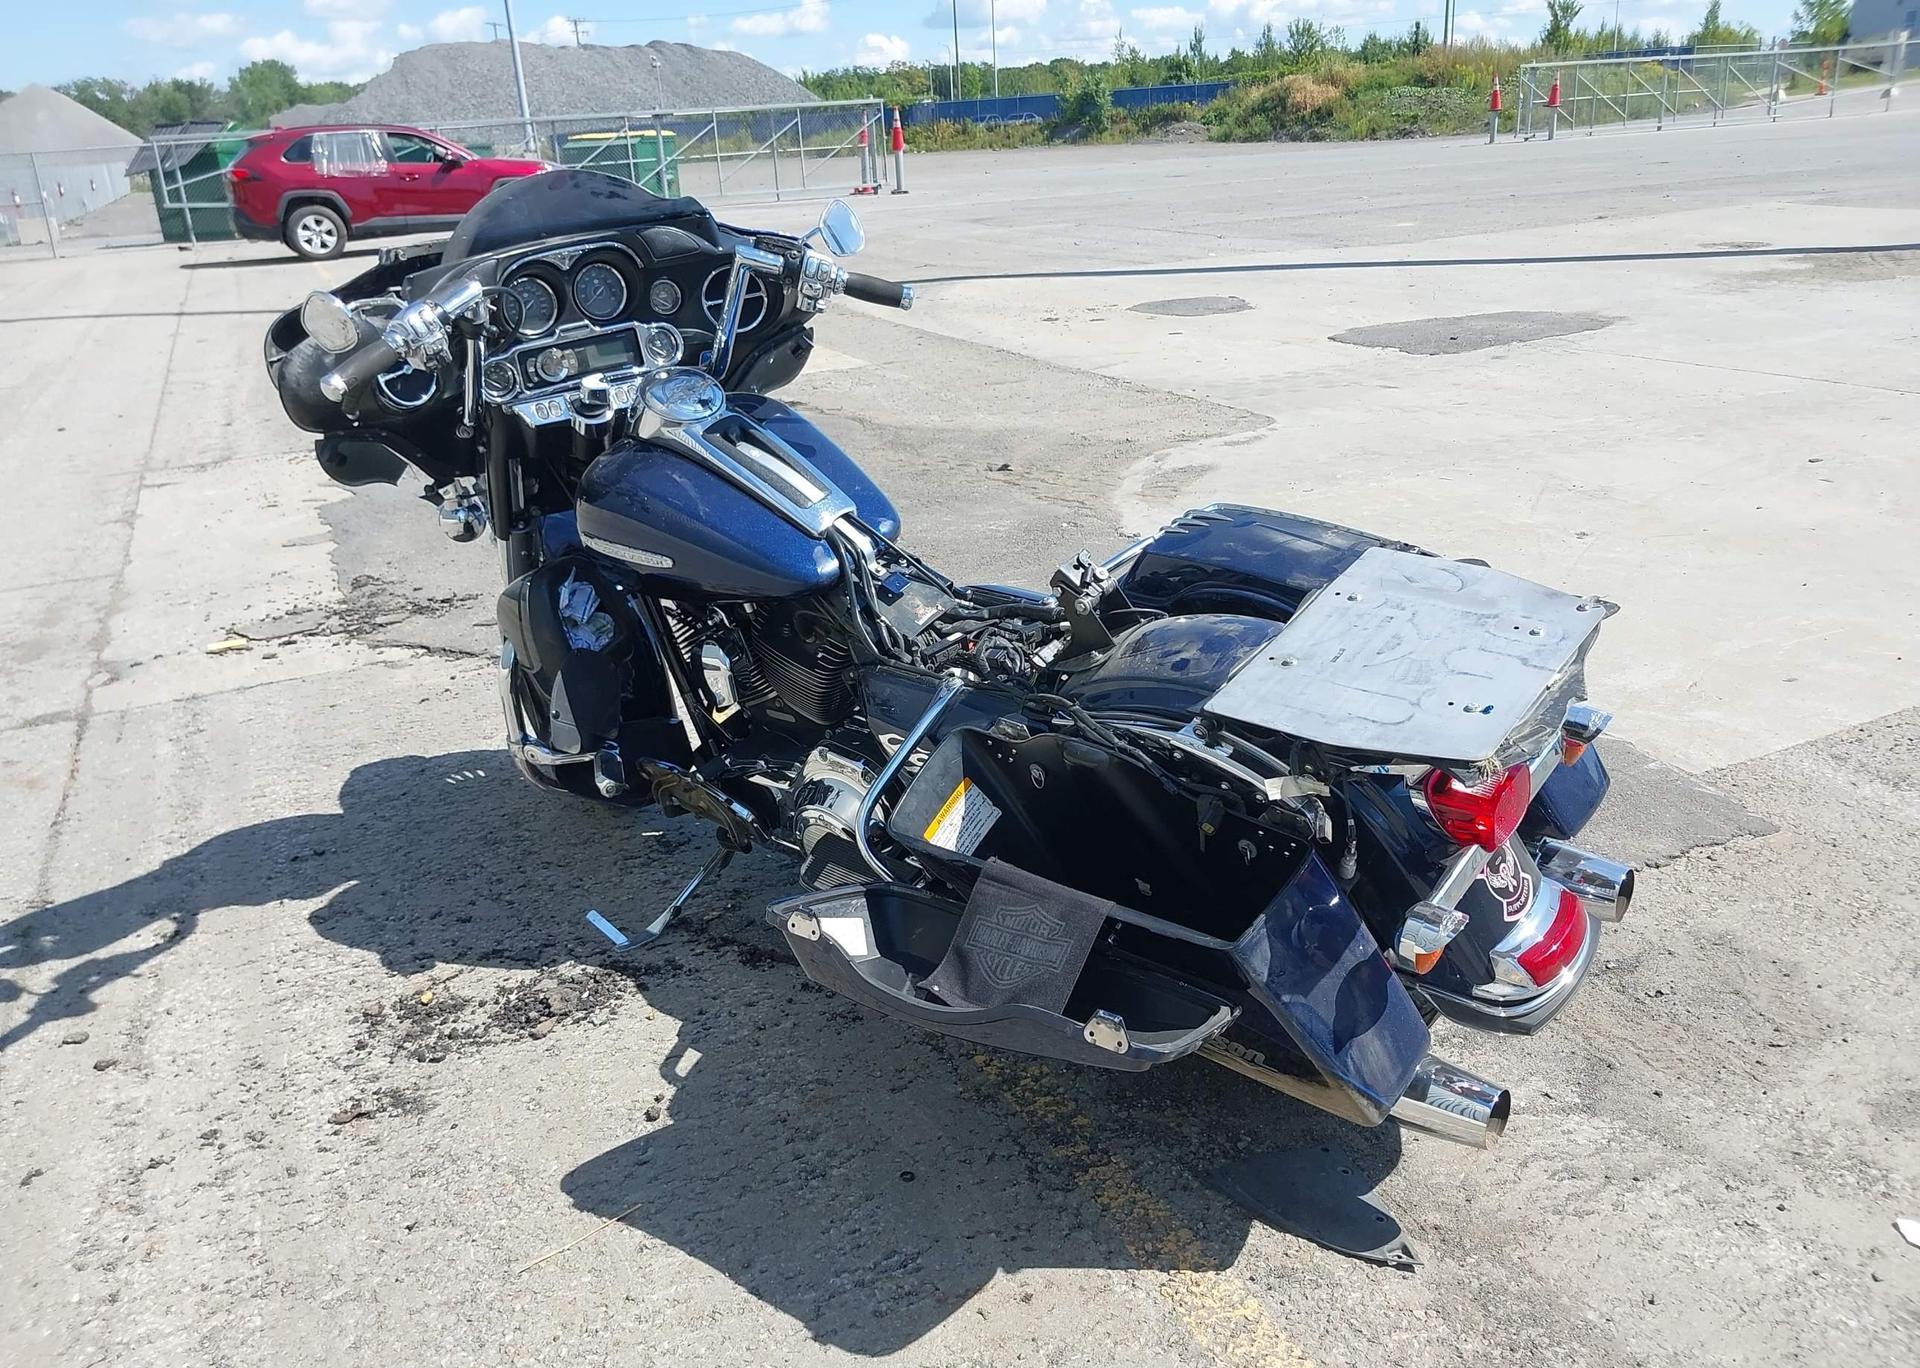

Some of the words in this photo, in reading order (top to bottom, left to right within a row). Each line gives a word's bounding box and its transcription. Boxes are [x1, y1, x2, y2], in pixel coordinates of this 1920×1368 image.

[940, 790, 963, 819] WARNING
[1003, 914, 1051, 937] MOTOR
[974, 925, 1063, 964] HARLEY-DAVIDSON
[987, 951, 1033, 979] CYCLES
